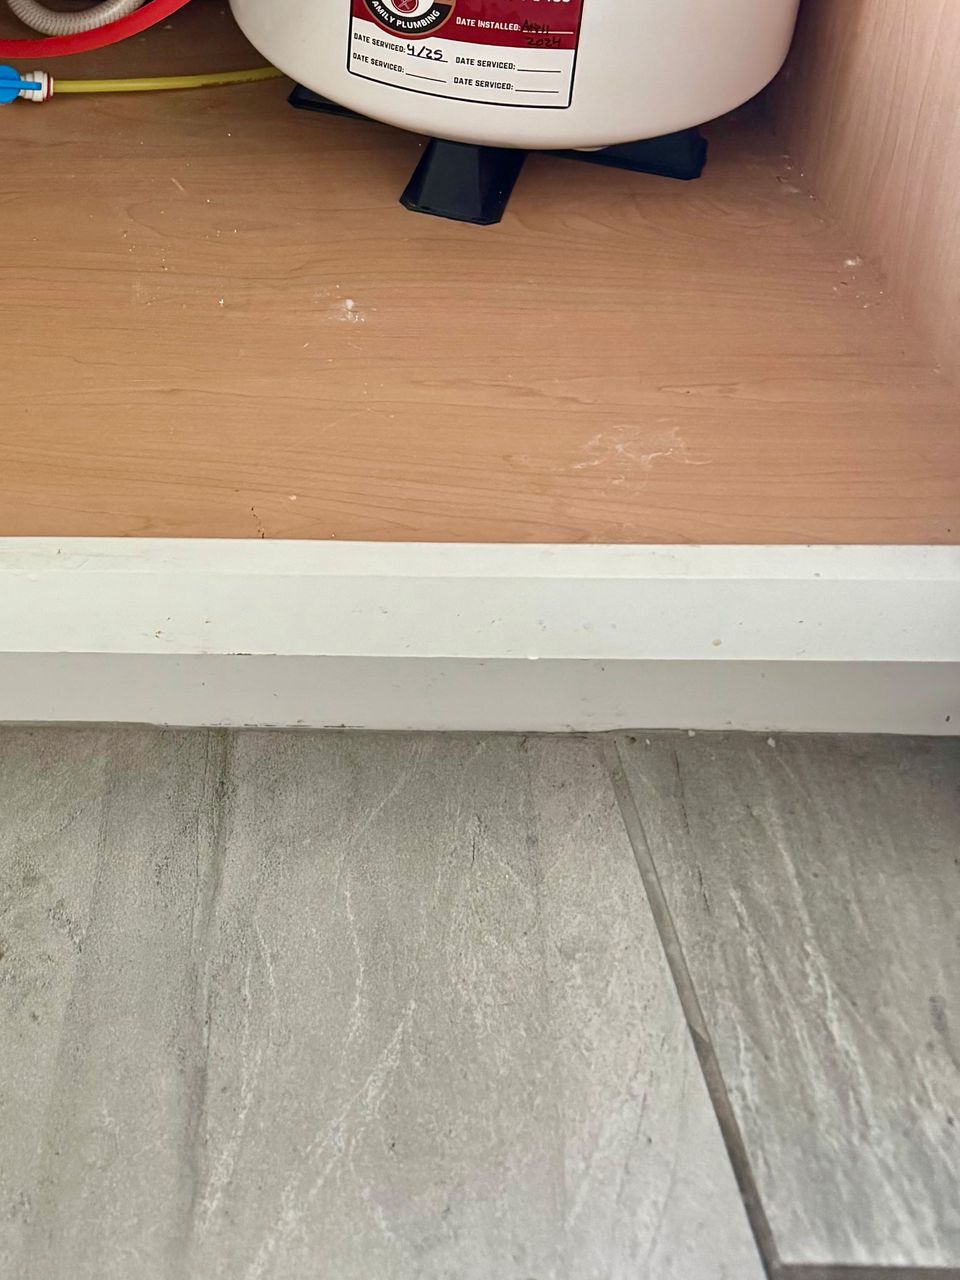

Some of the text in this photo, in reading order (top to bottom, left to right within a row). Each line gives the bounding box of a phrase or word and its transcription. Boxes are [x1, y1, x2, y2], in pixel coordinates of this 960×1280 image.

[396, 9, 440, 29] PLUMBING
[456, 16, 521, 32] DATE INSTALLED:
[353, 32, 406, 53] DATE SERVICED:
[407, 43, 444, 61] 4/25
[353, 52, 405, 73] DATE SERVICED:
[455, 56, 516, 70] DATE SERVICED:
[453, 76, 514, 90] DATE SERVICED:
